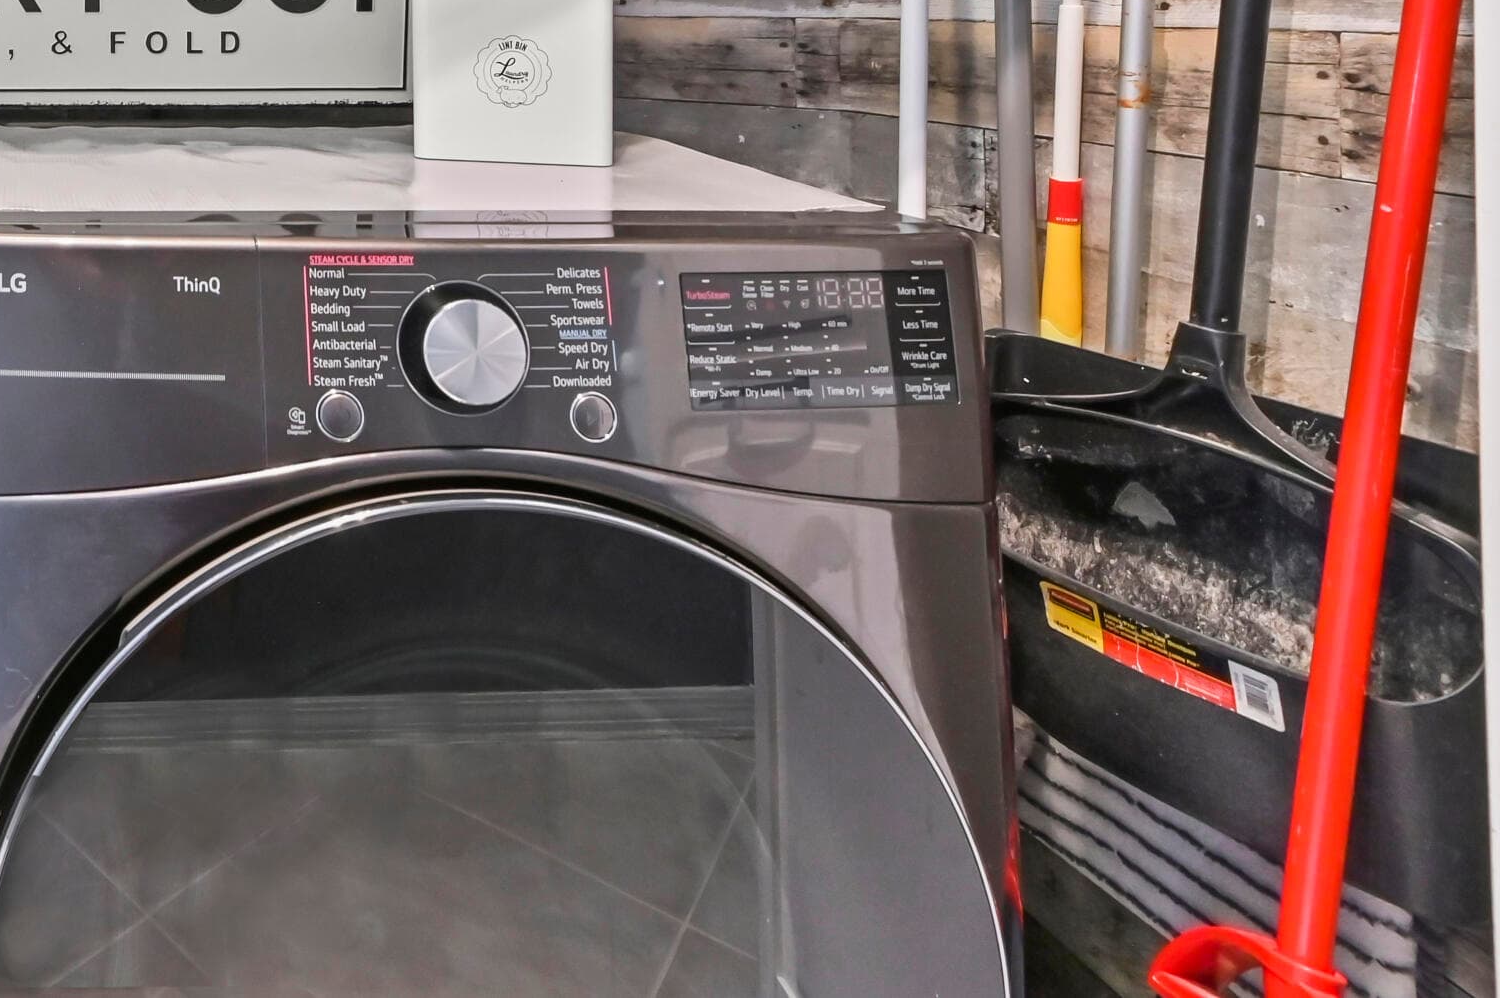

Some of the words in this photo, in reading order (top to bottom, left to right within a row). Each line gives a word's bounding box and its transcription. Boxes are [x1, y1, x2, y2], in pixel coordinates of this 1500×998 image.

[51, 30, 74, 55] &
[110, 31, 241, 55] FOLD
[498, 40, 513, 51] LINT
[514, 40, 528, 52] BIN
[309, 255, 335, 265] STEAM
[336, 255, 359, 265] CYCLE
[368, 255, 398, 265] SENSOR
[399, 255, 414, 265] DRY
[309, 267, 345, 279] Normal
[556, 267, 601, 279] Delicates
[173, 276, 221, 294] ThinQ
[546, 283, 574, 295] Perm.
[576, 283, 603, 295] Press
[897, 287, 916, 295] More
[917, 286, 935, 295] Time
[309, 285, 340, 299] Heavy
[342, 285, 367, 299] Duty
[686, 290, 731, 300] TurboSteam
[310, 302, 351, 317] Bedding
[572, 298, 605, 309] Towels
[311, 321, 339, 332] Small
[341, 320, 366, 332] Load
[550, 314, 605, 328] Sportswear
[902, 320, 920, 329] Less
[921, 320, 939, 329] Time
[716, 323, 733, 332] Start
[559, 329, 590, 339] MANUAL
[591, 329, 608, 339] DRY
[312, 339, 377, 351] Antibacterial
[558, 342, 589, 356] Speed
[591, 342, 609, 356] Dry
[690, 355, 714, 364] Reduce
[715, 355, 737, 364] Static
[902, 351, 929, 361] Wrinkle
[930, 351, 947, 360] Care
[313, 357, 342, 369] Steam
[575, 358, 590, 370] Air
[592, 358, 610, 373] Dry
[314, 375, 346, 387] Steam
[553, 375, 612, 388] Downloaded
[719, 388, 740, 398] Saver
[745, 387, 759, 399] Dry
[761, 387, 781, 397] Level
[793, 386, 815, 398] Temp.
[827, 386, 845, 396] Time
[846, 386, 859, 398] Dry
[871, 385, 894, 397] Signal
[905, 383, 921, 393] Damp
[922, 383, 933, 392] Dry
[933, 382, 951, 392] Signal
